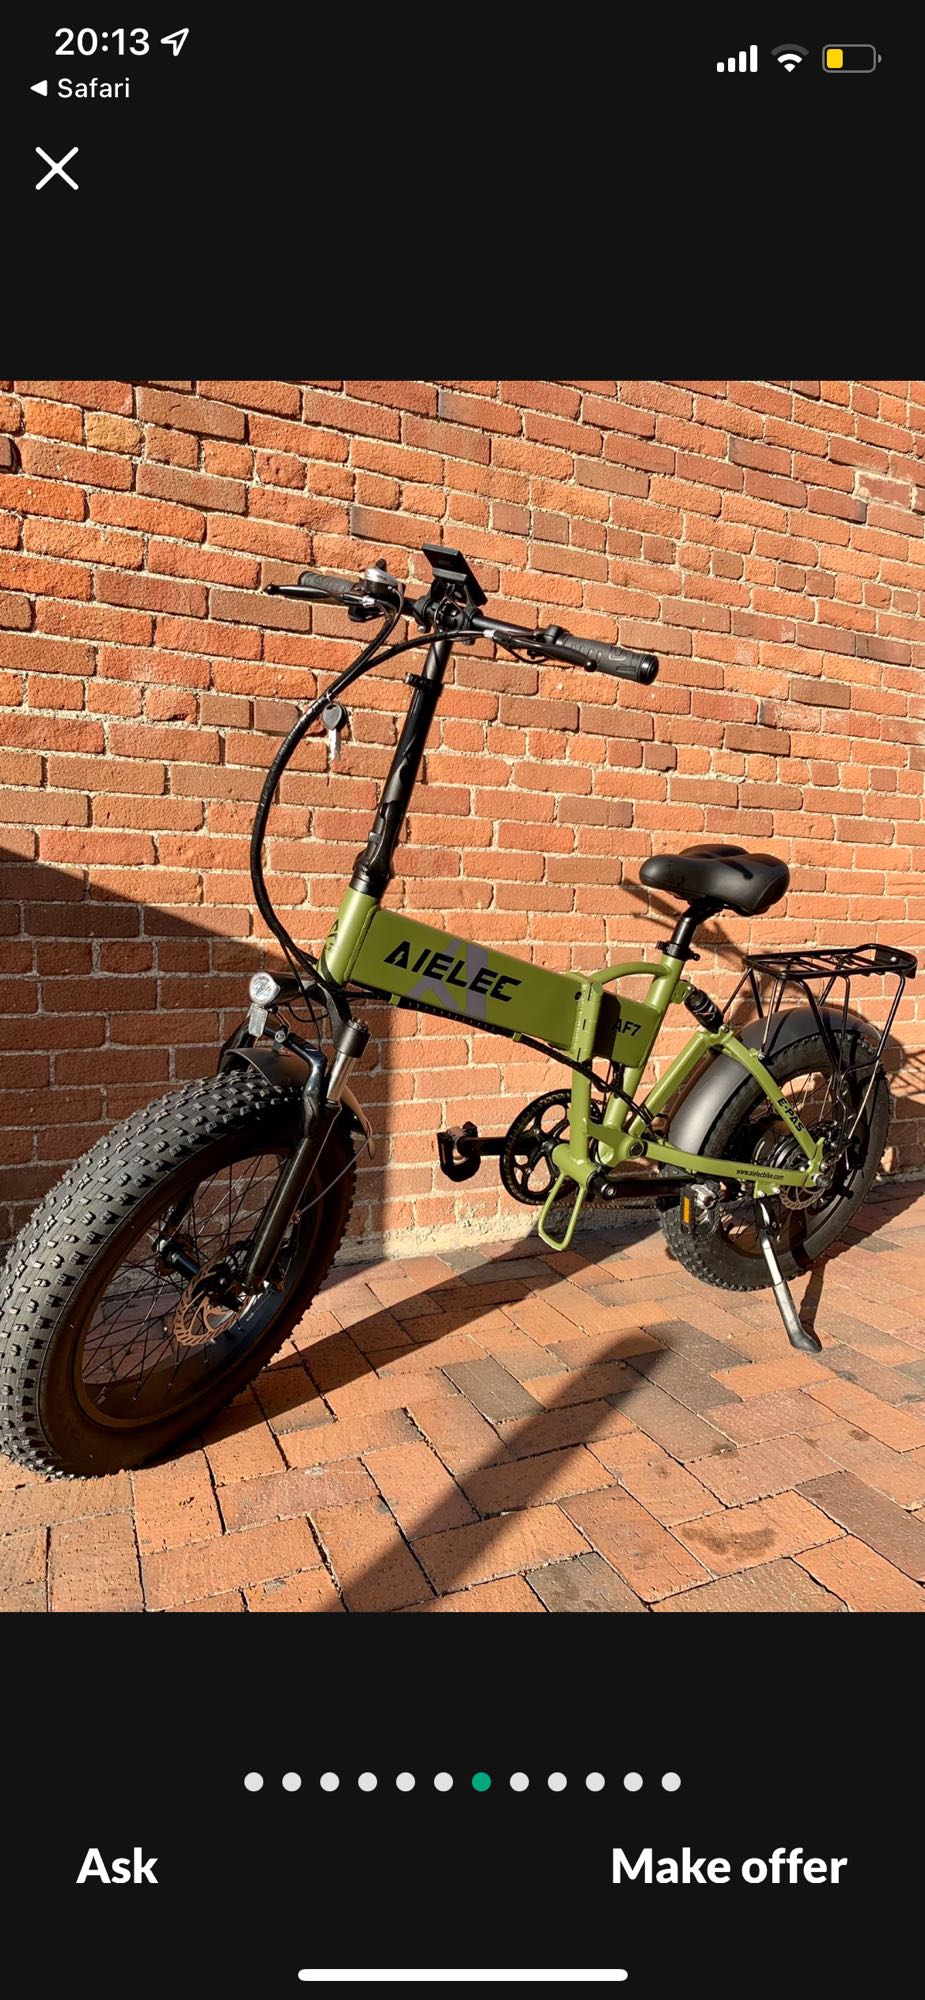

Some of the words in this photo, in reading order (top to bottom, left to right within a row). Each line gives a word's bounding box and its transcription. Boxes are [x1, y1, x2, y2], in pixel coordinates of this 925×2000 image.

[384, 940, 522, 1002] AIELEC
[611, 1019, 642, 1036] AF7
[777, 1098, 804, 1132] E-PAS
